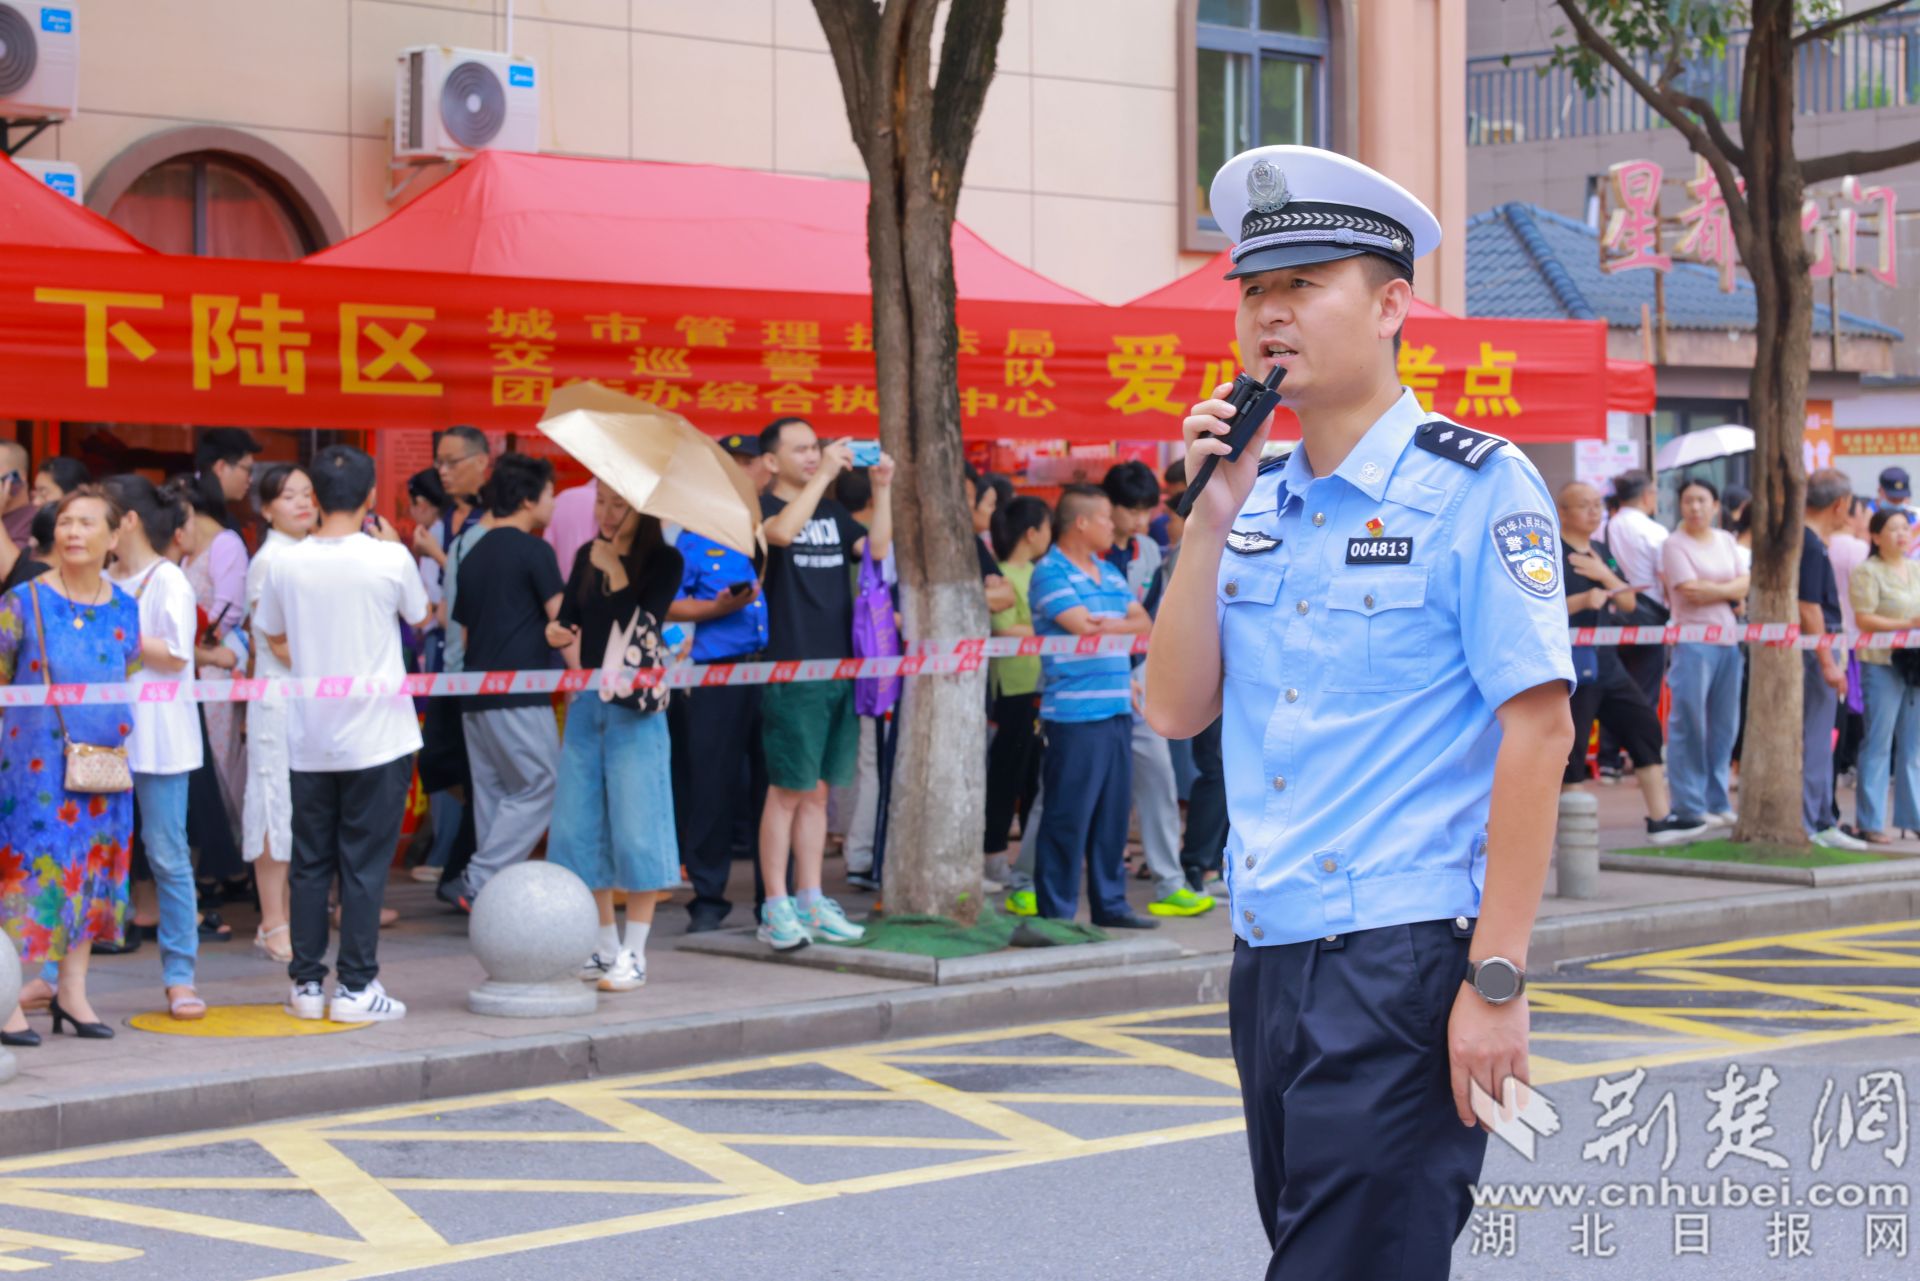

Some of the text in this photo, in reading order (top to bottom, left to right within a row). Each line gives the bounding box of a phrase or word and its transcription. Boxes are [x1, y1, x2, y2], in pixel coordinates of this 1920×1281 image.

[35, 287, 443, 397] 下陆区
[489, 341, 1055, 387] 交巡警队
[492, 374, 1056, 417] 团办综合执中心
[1107, 333, 1522, 417] 爱心考点
[1350, 541, 1408, 558] 004813
